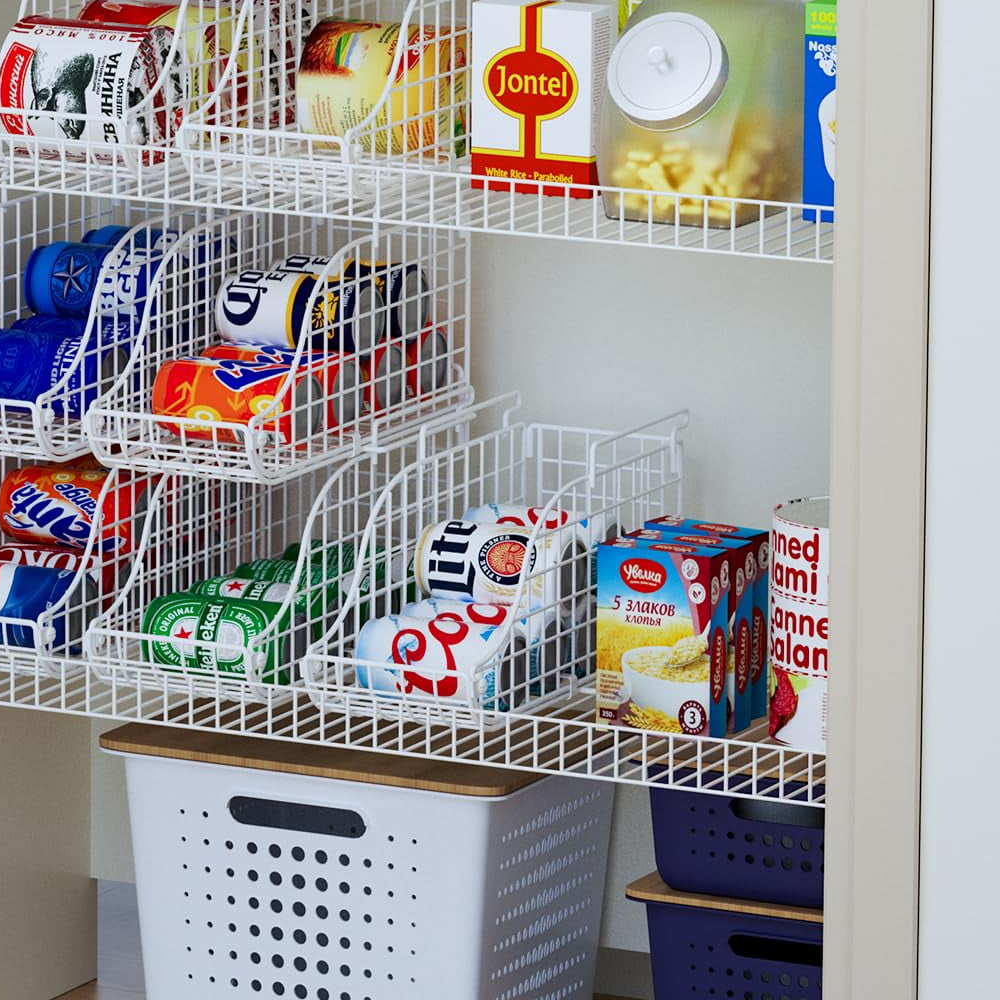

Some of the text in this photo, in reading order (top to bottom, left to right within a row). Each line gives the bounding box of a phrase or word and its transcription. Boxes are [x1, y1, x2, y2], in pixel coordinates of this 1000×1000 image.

[34, 28, 79, 38] МЯСО
[88, 33, 124, 42] 100%
[495, 65, 567, 97] Jontel
[485, 167, 508, 178] White
[510, 169, 526, 179] Rice
[481, 535, 510, 559] PILSNER
[428, 521, 478, 602] Lite
[623, 564, 662, 582] Увелка
[612, 595, 621, 610] 5
[160, 606, 194, 632] ORIGINAL
[688, 711, 696, 724] 3
